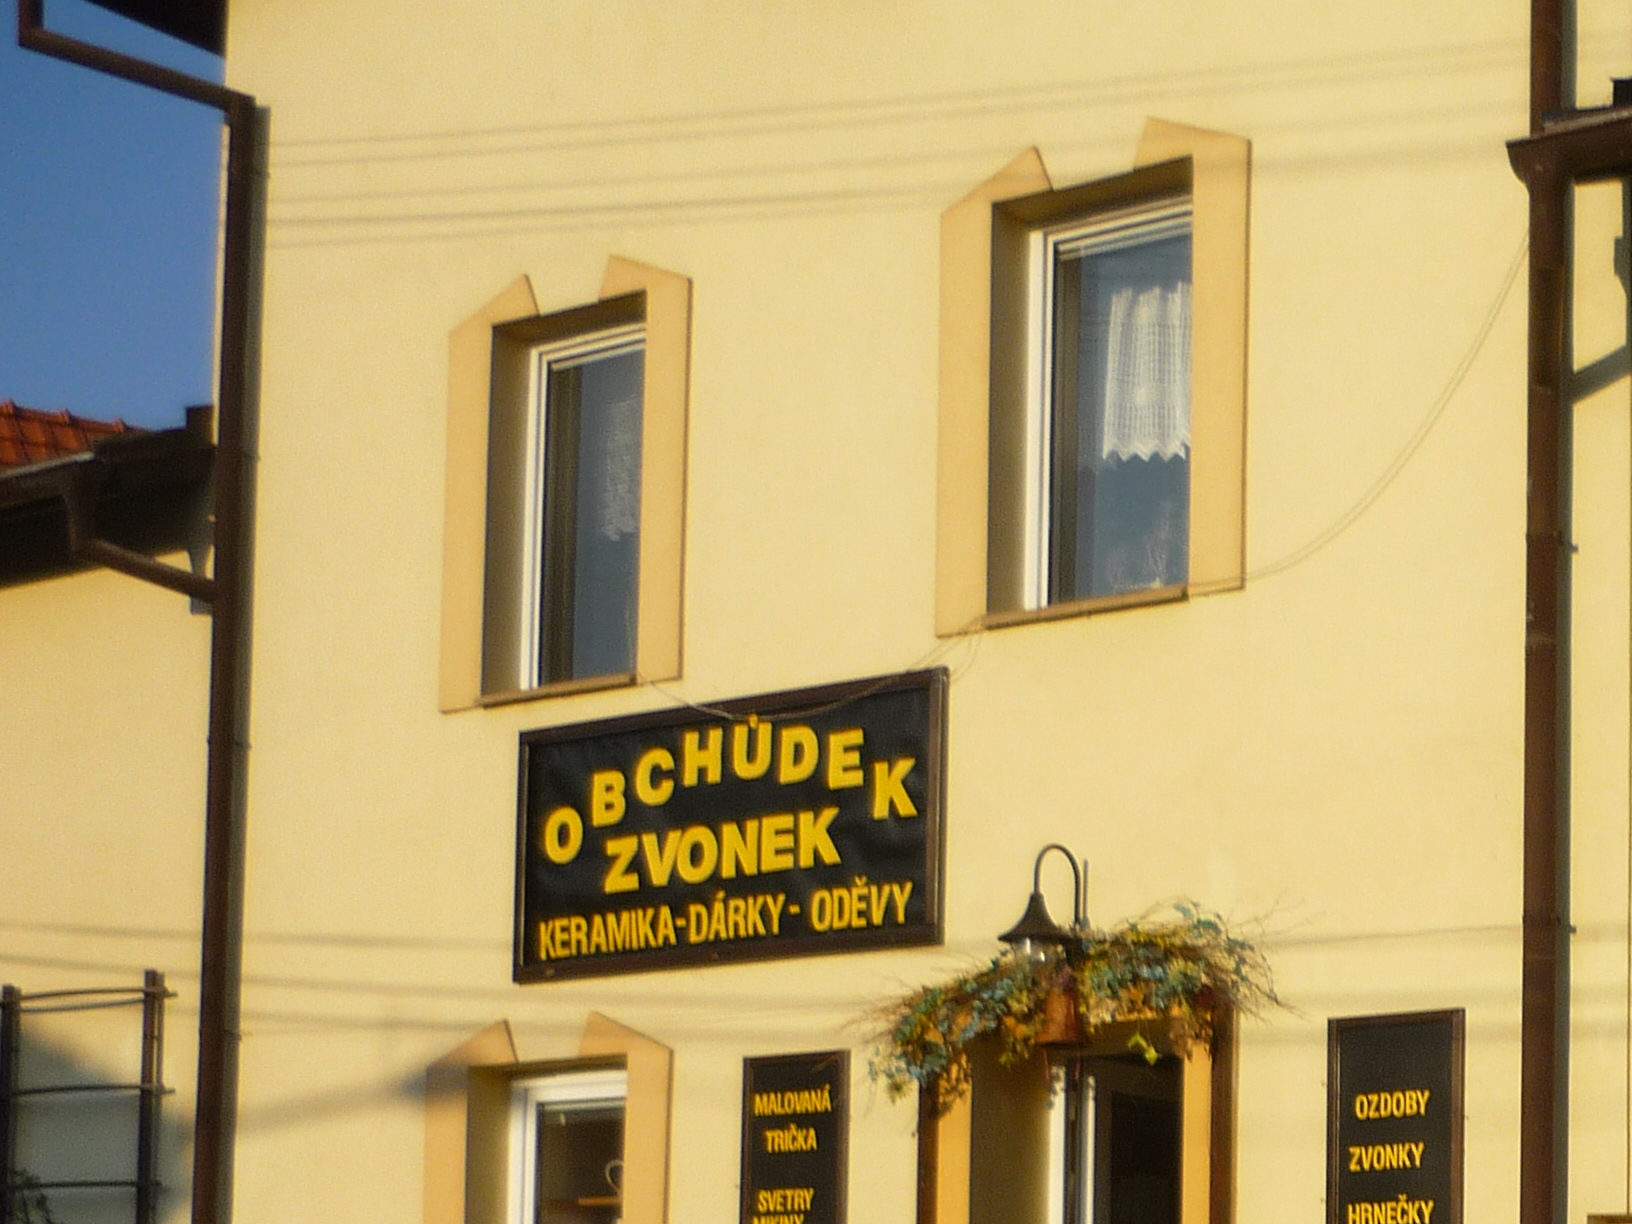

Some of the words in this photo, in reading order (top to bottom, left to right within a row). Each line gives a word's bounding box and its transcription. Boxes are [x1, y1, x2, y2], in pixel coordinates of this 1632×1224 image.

[542, 713, 916, 864] OBCHŮDEK
[603, 806, 840, 894] ZVONEK
[809, 876, 913, 933] ODĚVY
[754, 1085, 830, 1115] MALOVANÁ
[1355, 1090, 1429, 1119] OZDOBY
[764, 1124, 816, 1151] TRIČKA
[1349, 1142, 1424, 1171] ZVONKY
[757, 1188, 813, 1212] SVETRY
